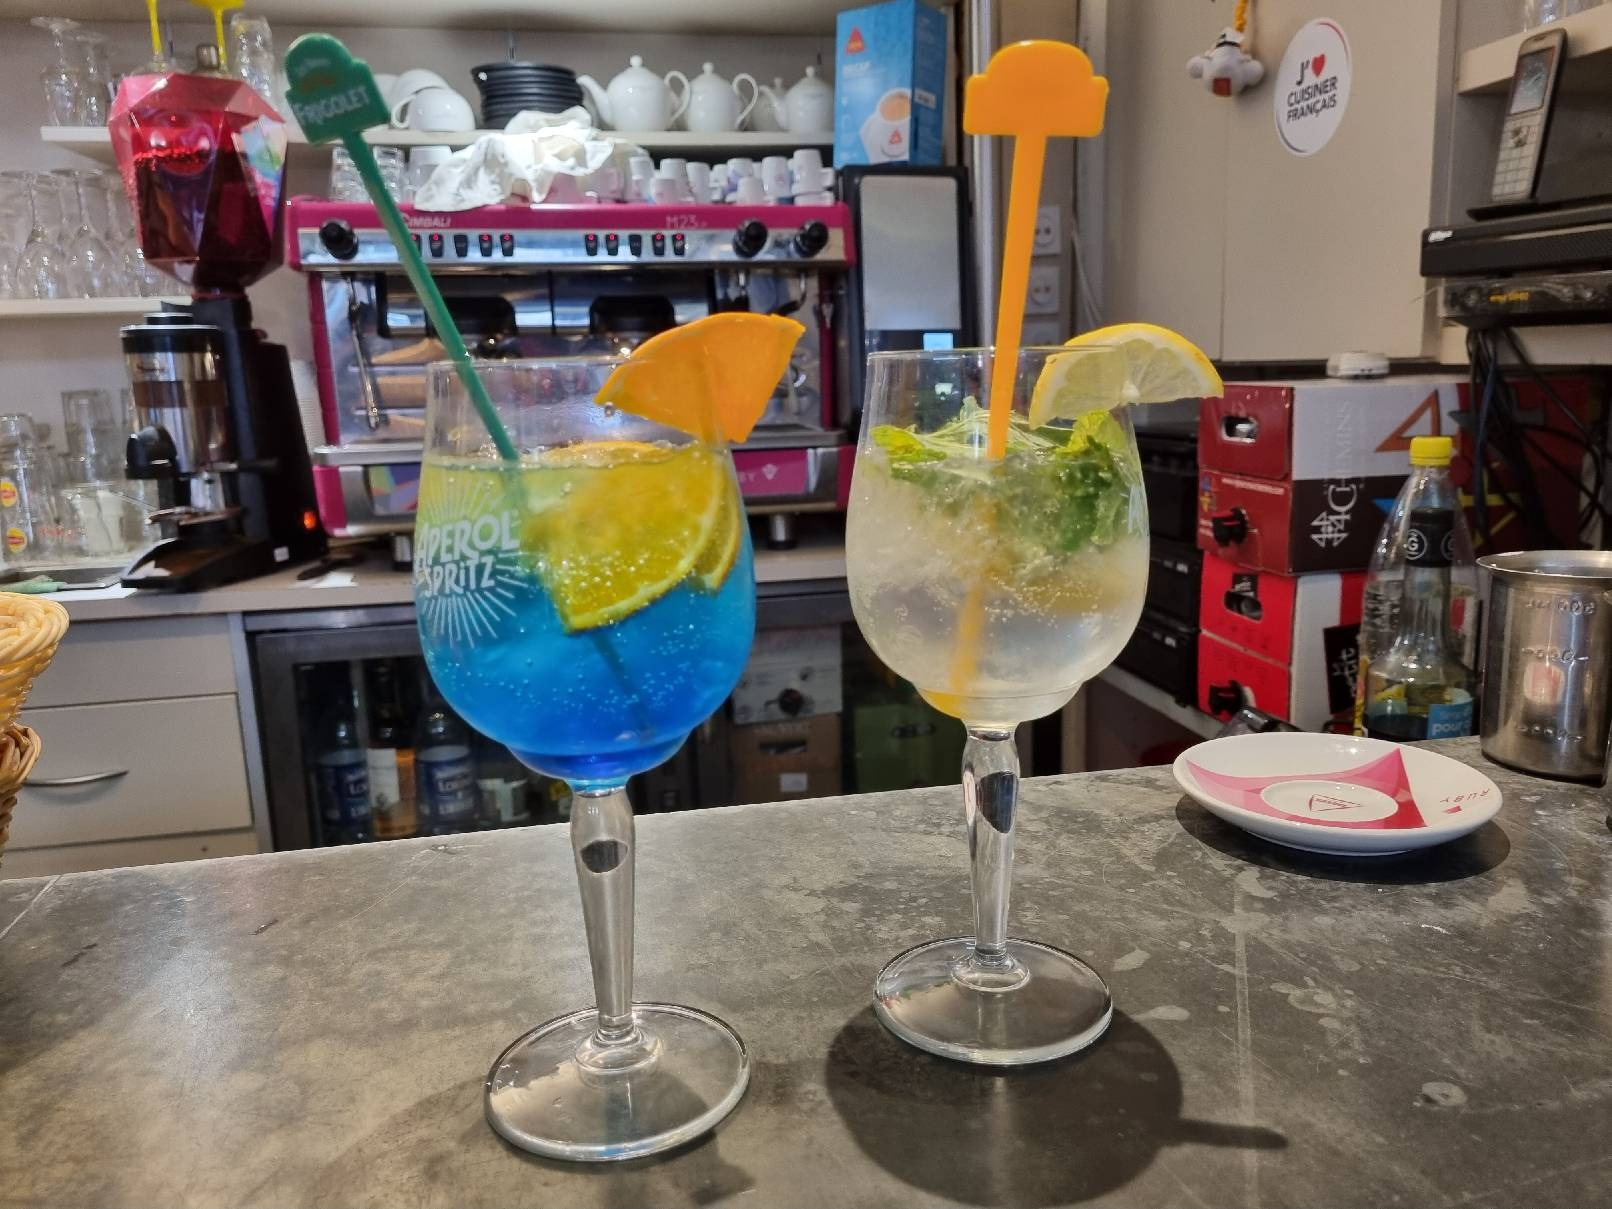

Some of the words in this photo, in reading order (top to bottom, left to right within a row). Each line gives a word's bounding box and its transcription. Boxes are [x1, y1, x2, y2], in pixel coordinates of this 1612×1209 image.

[1286, 76, 1338, 107] CUISINER
[1286, 93, 1337, 123] FRANÇAIS
[415, 511, 520, 568] APEROL
